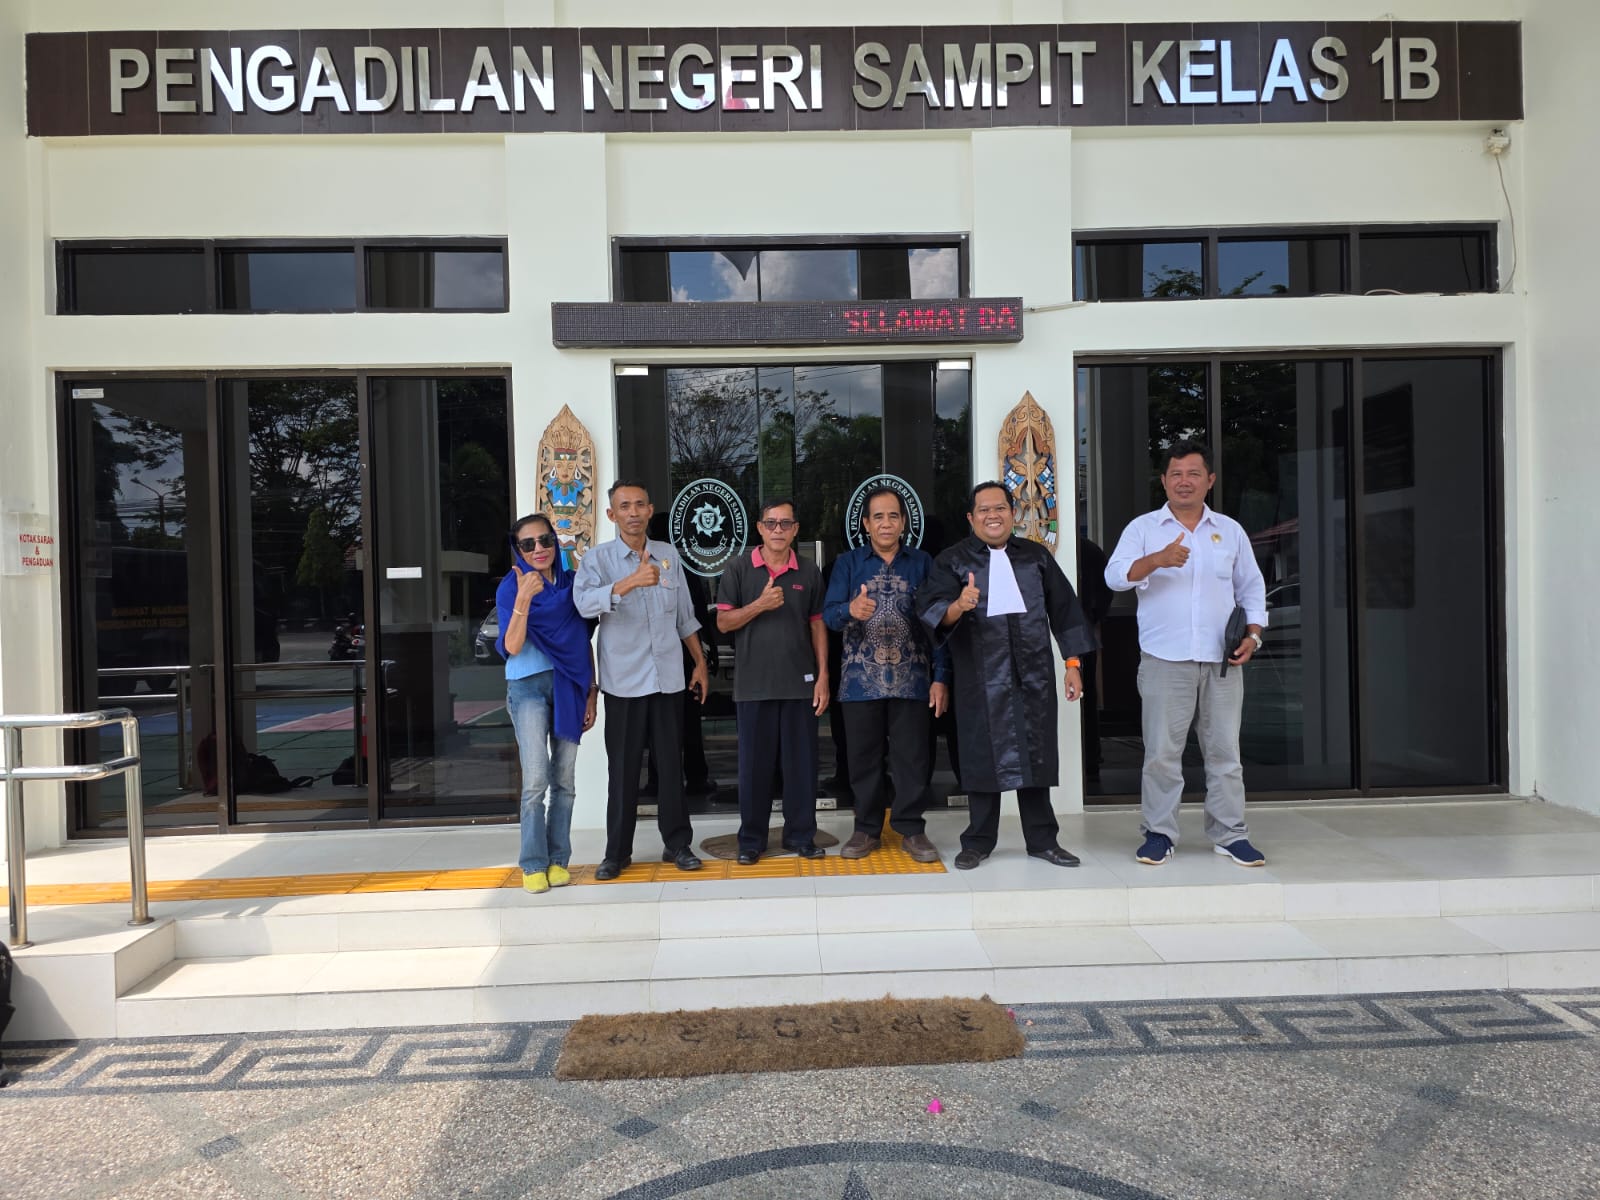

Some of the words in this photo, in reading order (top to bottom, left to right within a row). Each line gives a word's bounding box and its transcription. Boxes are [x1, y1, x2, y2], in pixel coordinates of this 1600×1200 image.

[109, 45, 556, 114] PENGADILAN
[581, 43, 824, 112] NEGERI
[852, 40, 1097, 110] SAMPIT
[1132, 36, 1350, 105] KELAS
[1370, 37, 1441, 101] 1B
[673, 485, 702, 535] PENGADILAN
[702, 483, 734, 504] NEGERI
[730, 501, 743, 534] SAMPIT
[850, 480, 878, 531] PENGADILAN
[880, 479, 910, 500] NEGERI
[907, 497, 920, 529] SAMPIT
[19, 534, 37, 543] KOTAK
[37, 535, 54, 544] SARAN
[35, 545, 40, 555] &
[22, 557, 54, 567] PENGADUAN
